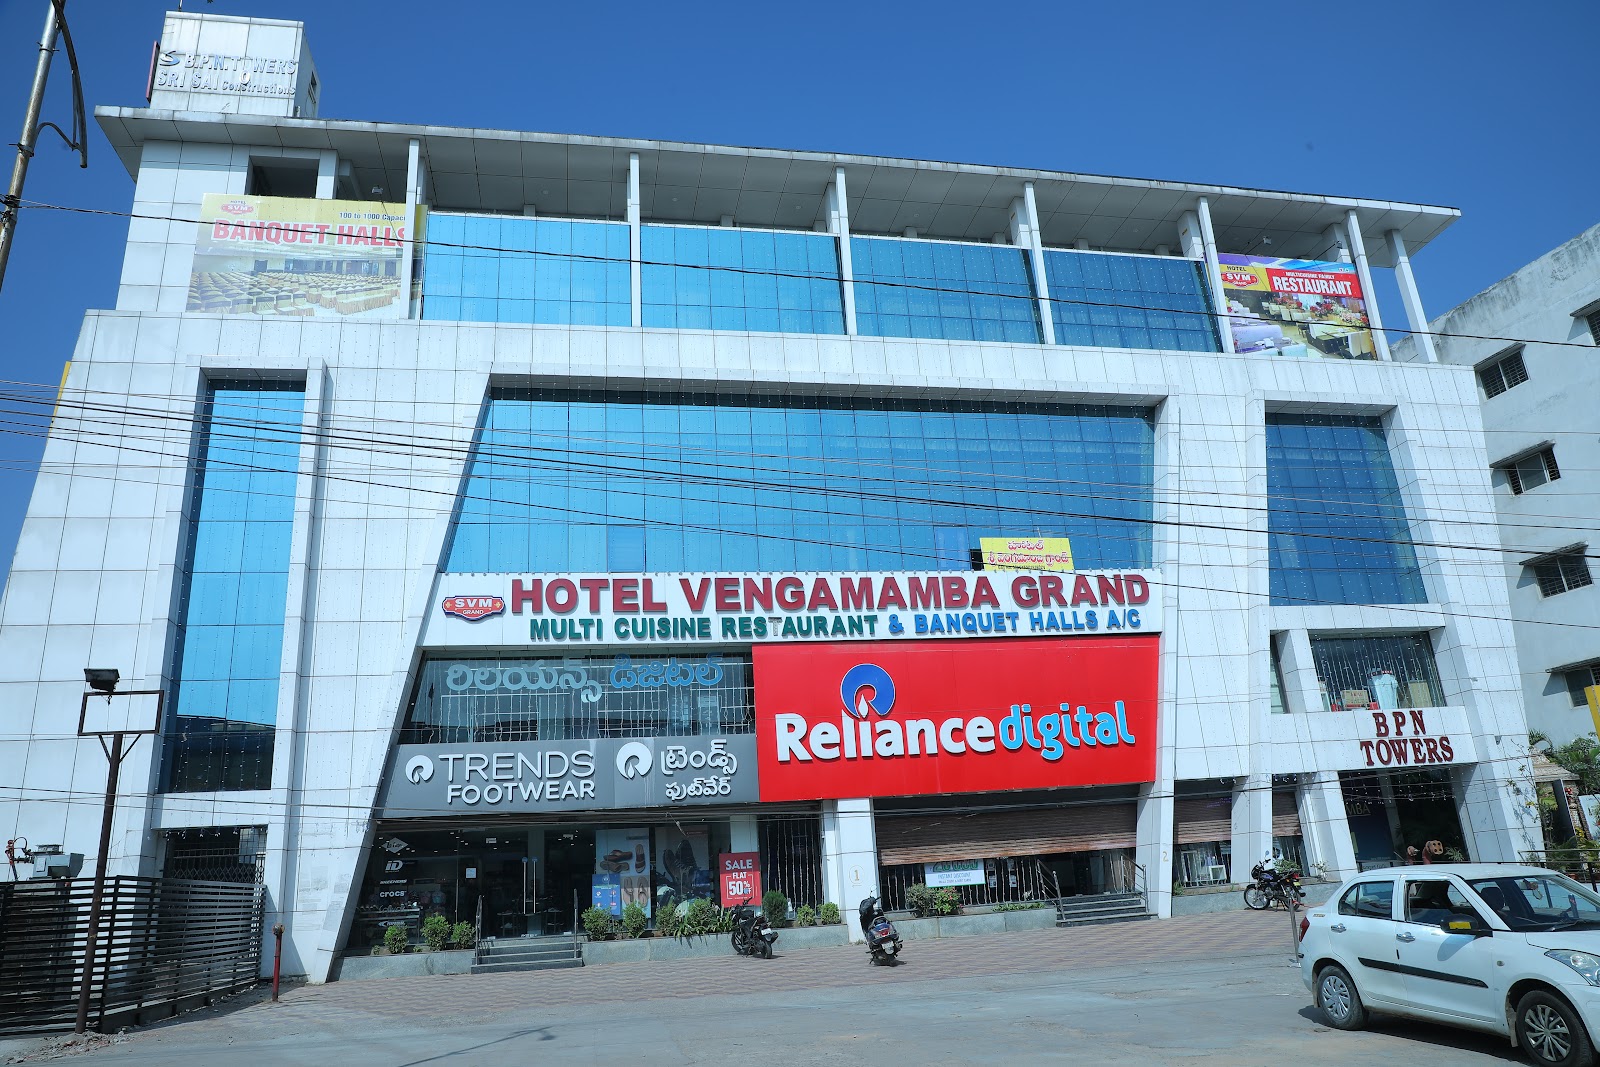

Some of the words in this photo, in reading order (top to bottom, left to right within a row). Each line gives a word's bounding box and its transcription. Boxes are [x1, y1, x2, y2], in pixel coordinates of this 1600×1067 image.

[157, 70, 186, 88] SRI
[192, 72, 220, 90] SAI
[222, 81, 296, 96] Constructions
[213, 220, 330, 244] BANQUET
[1272, 276, 1352, 296] RESTAURANT
[454, 598, 493, 609] SVM
[511, 578, 668, 614] HOTEL
[679, 576, 1000, 612] VENGAMAMBA
[1012, 574, 1150, 608] GRAND
[530, 618, 602, 640] MULTI
[614, 617, 711, 638] CUISINE
[722, 615, 878, 637] RESTAURANT
[888, 613, 904, 633] &
[915, 612, 1018, 634] BANQUET
[1030, 610, 1098, 631] HALLS
[1107, 608, 1142, 628] A/C
[775, 709, 996, 762] Reliance
[999, 700, 1136, 761] digital
[1372, 710, 1426, 738] BPN
[1360, 736, 1454, 767] TOWERS
[438, 750, 596, 781] TRENDS
[447, 780, 596, 804] FOOTWEAR
[726, 859, 752, 870] SALE
[1163, 851, 1168, 862] 2
[854, 870, 860, 881] 1
[728, 881, 750, 895] 50%
